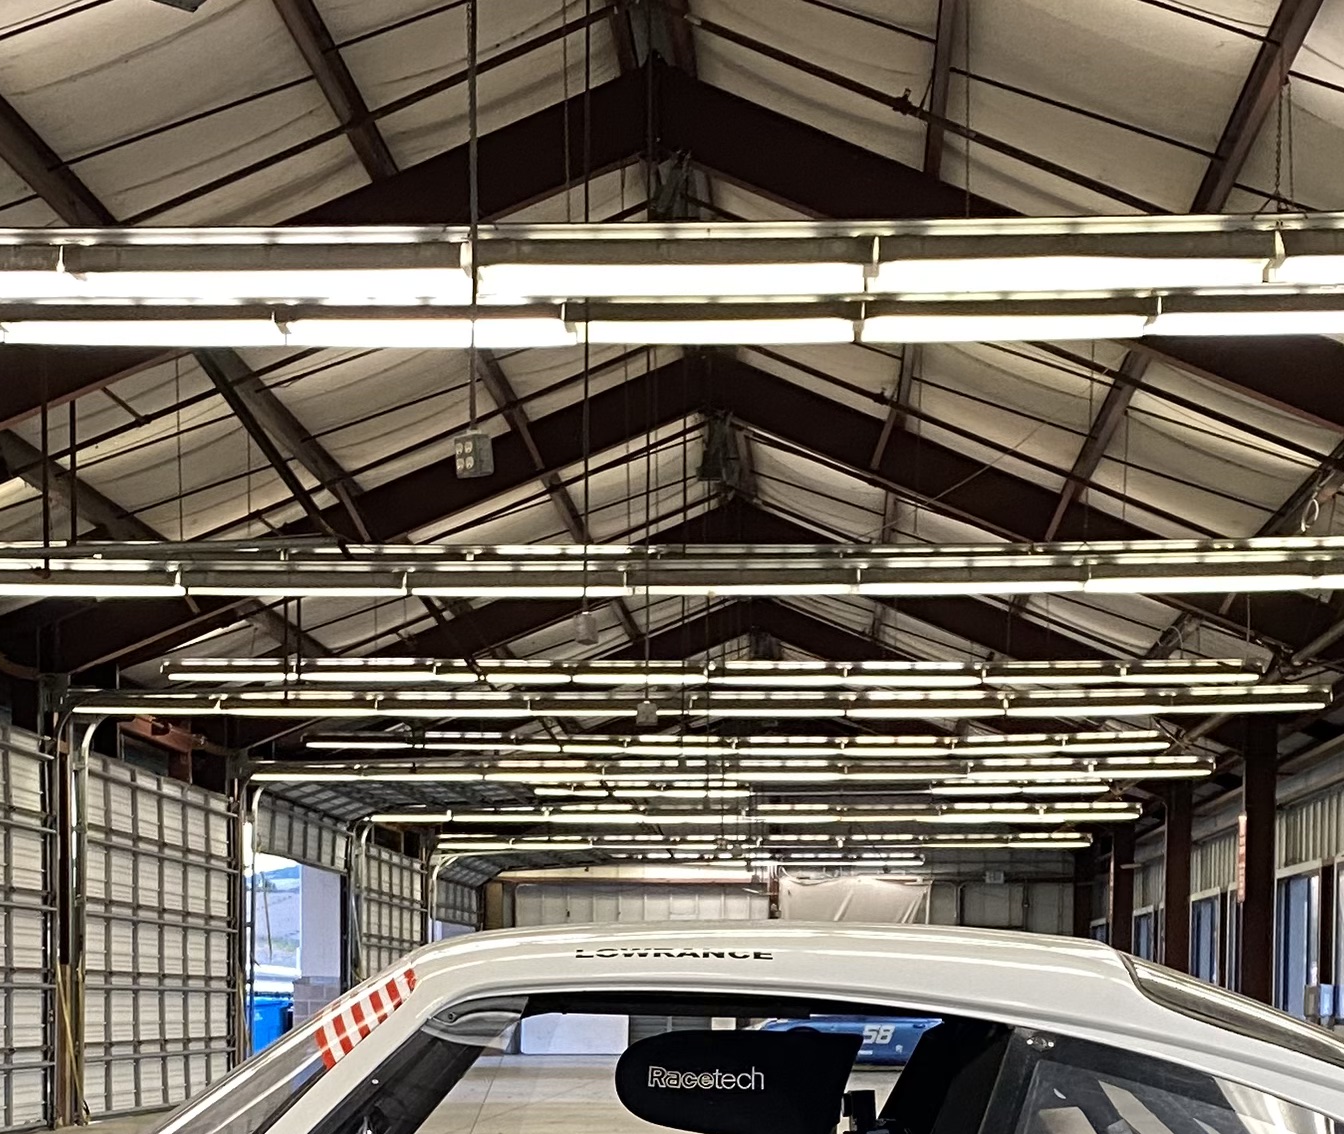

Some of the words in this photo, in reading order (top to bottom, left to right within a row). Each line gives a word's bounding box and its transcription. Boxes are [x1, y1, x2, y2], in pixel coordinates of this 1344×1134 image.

[575, 947, 774, 961] LOWRANCE
[863, 1023, 896, 1044] 58
[647, 1065, 765, 1090] Racetech
